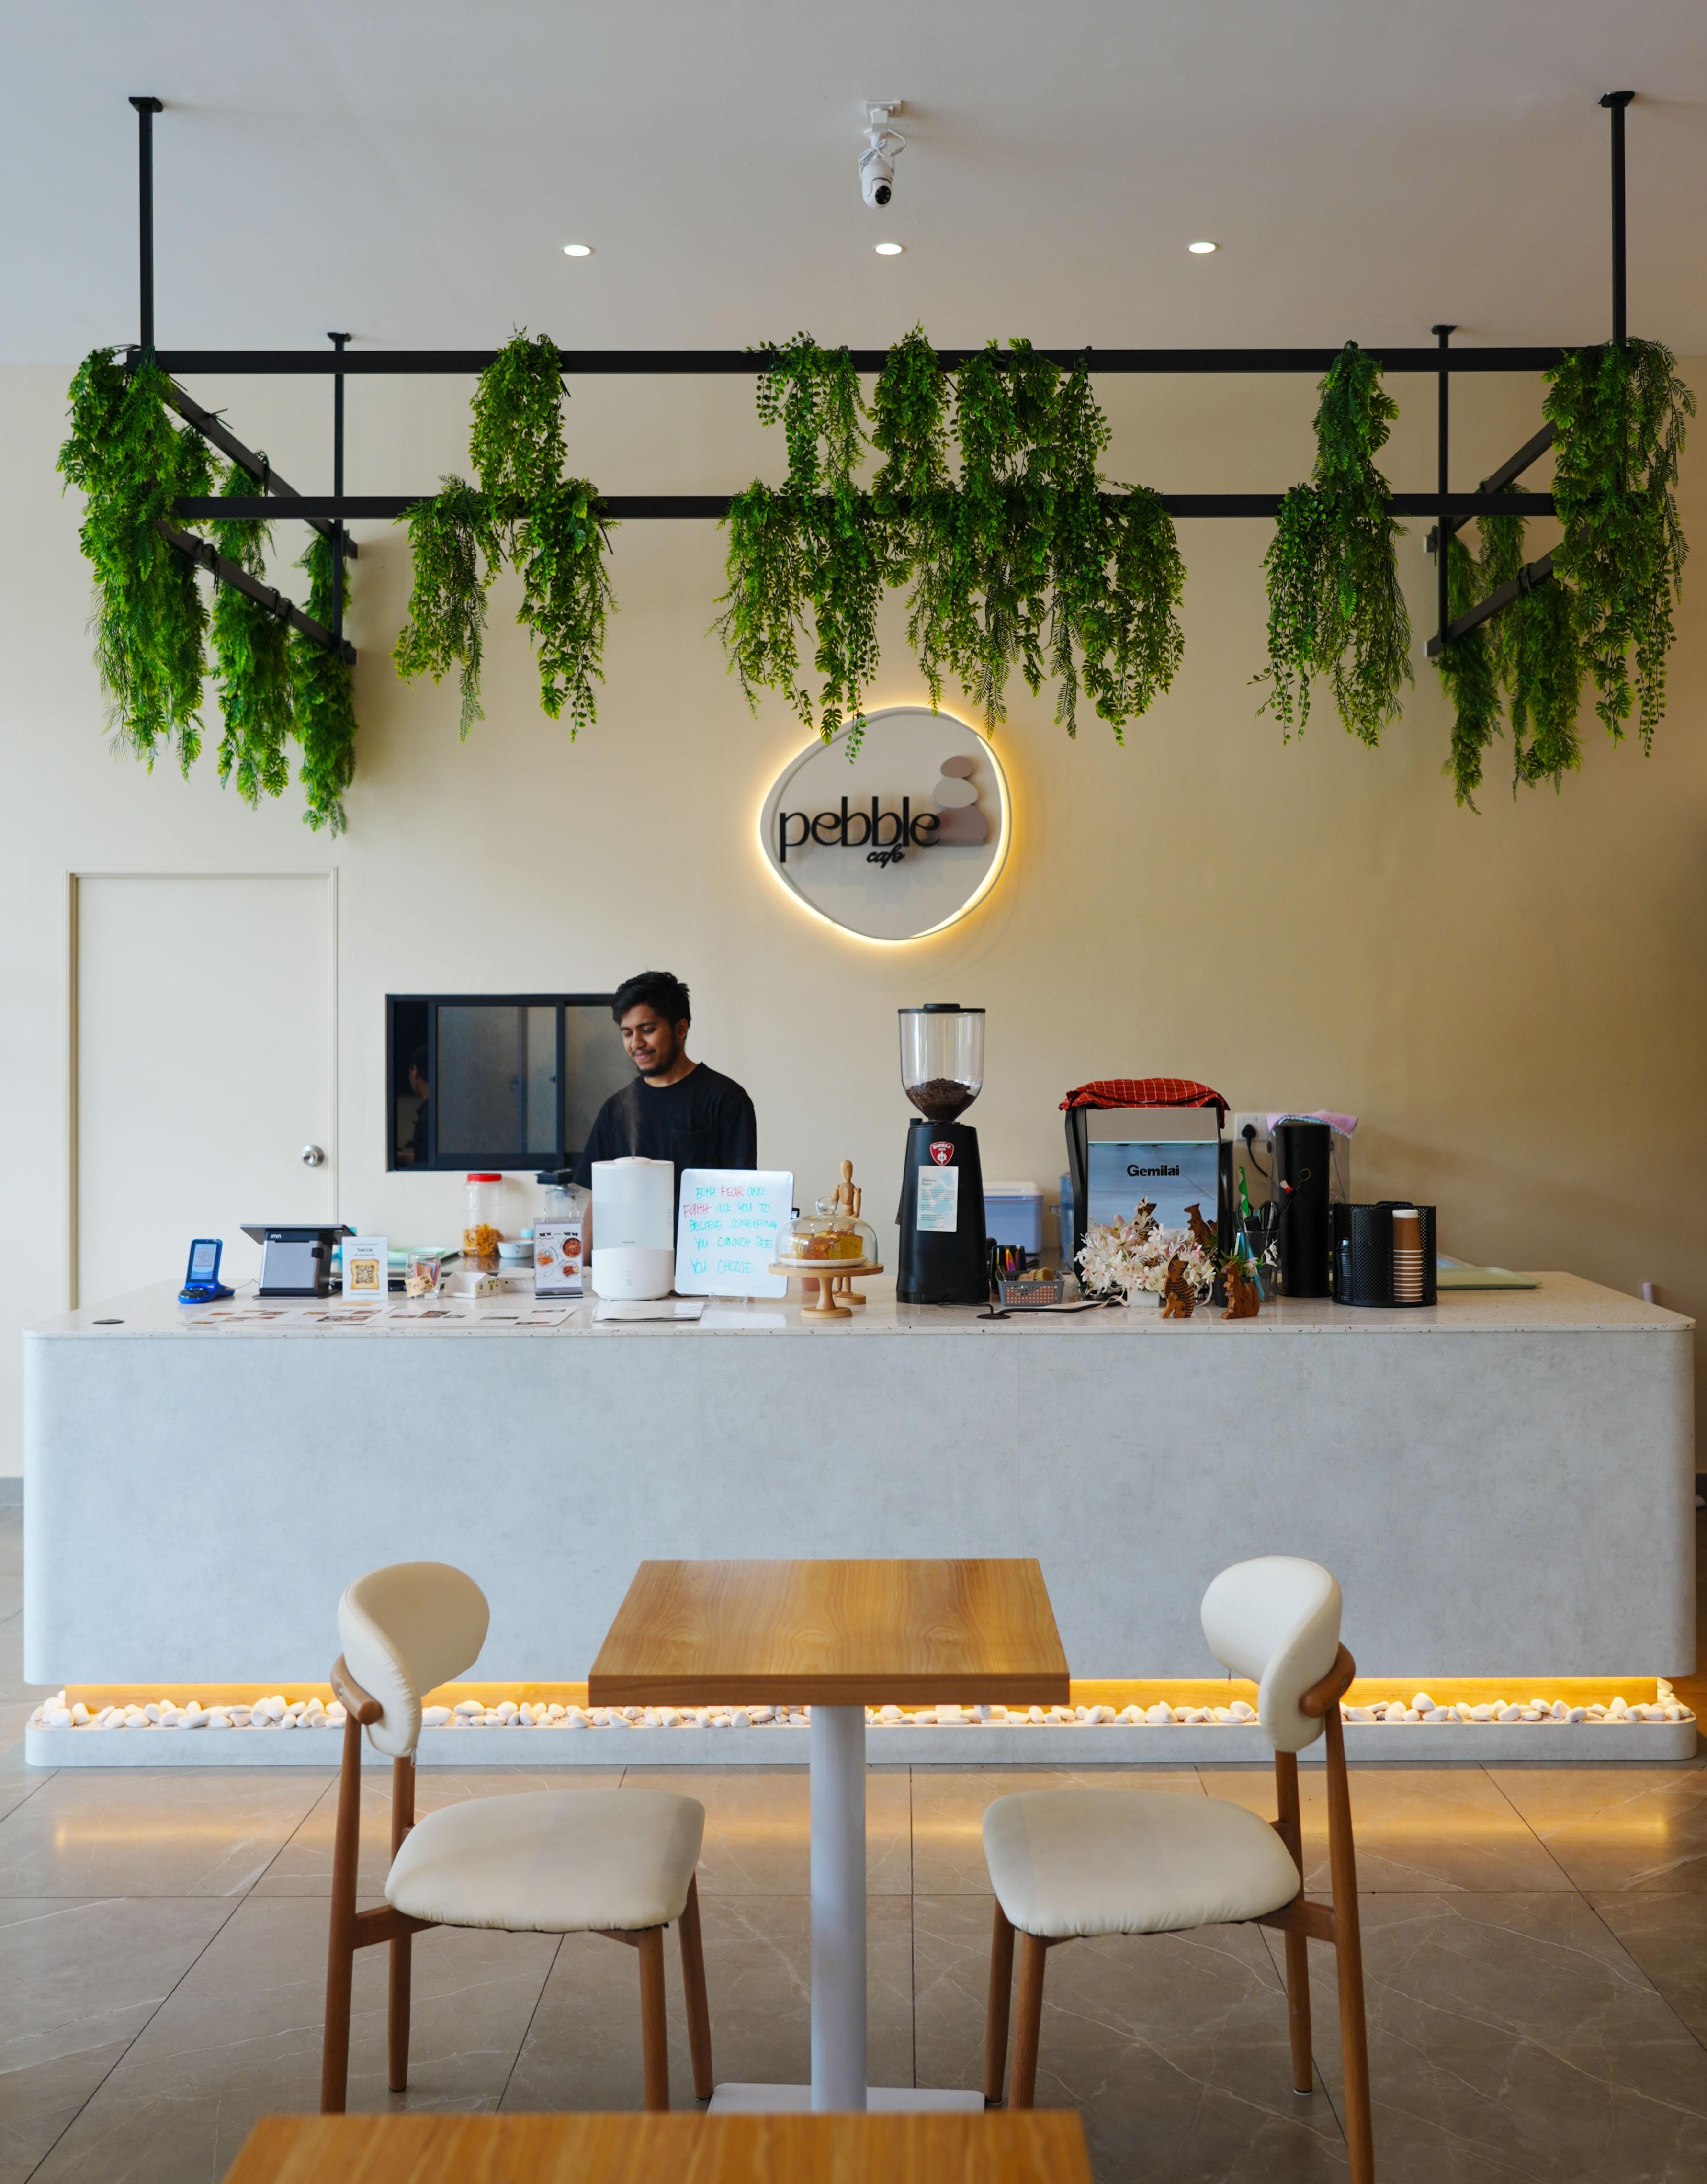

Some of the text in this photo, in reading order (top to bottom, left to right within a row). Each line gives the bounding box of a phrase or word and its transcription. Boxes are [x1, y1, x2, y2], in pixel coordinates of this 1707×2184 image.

[780, 796, 940, 862] pebble
[1127, 1165, 1179, 1177] Gemilai
[758, 1203, 770, 1213] TO
